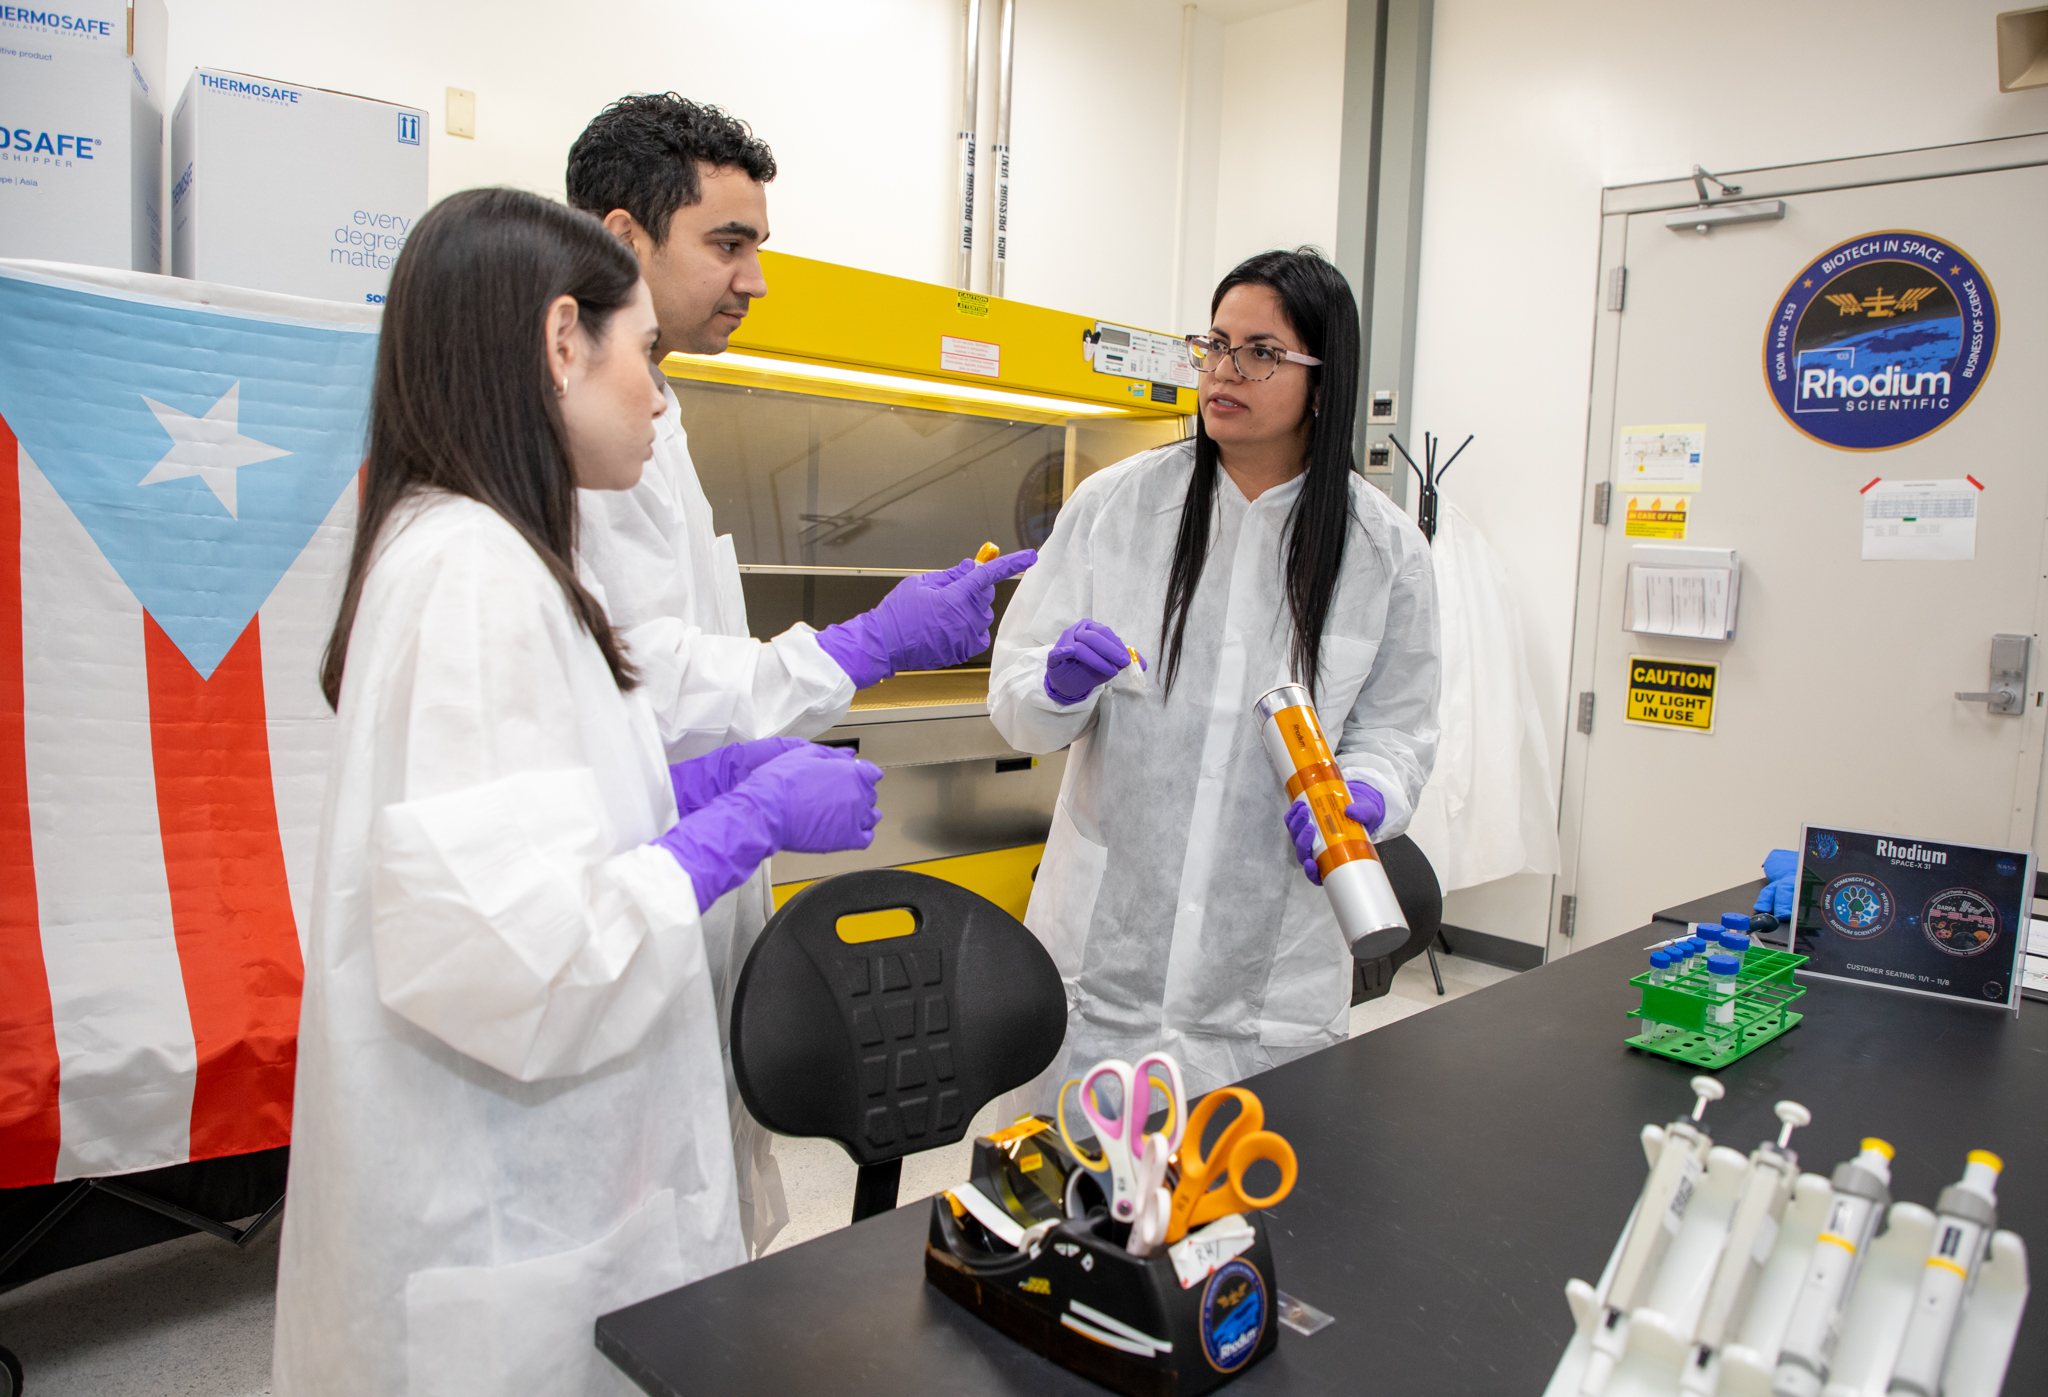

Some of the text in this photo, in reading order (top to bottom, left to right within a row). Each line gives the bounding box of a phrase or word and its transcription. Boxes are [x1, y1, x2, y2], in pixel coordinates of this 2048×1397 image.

[54, 29, 98, 40] SHIPPER
[19, 50, 53, 61] product
[2, 153, 73, 168] SHIPPER
[20, 178, 38, 187] Asia
[963, 141, 976, 250] LOW PRESSURE VENT
[997, 153, 1010, 260] HIGH PRESSURE VENT
[353, 210, 411, 235] every
[335, 225, 408, 252] degree
[1821, 240, 1945, 274] BIOTECH IN SPACE
[959, 292, 988, 302] CAUTION
[1962, 278, 1984, 379] BUSINESS OF SCIENCE
[1775, 302, 1797, 382] EST. 2014 WOSB
[1801, 365, 1952, 400] Rhodium
[1845, 397, 1951, 412] SCIENTIFIC
[1637, 512, 1656, 520] CASE
[1667, 513, 1684, 521] FIRE
[1633, 667, 1713, 689] CAUTION
[1635, 692, 1706, 710] UV LIGHT
[1643, 706, 1695, 722] IN USE
[1876, 839, 1947, 865] Rhodium
[1890, 859, 1923, 869] SPACE-X
[1833, 876, 1876, 889] DOMENECH LAB
[1936, 904, 1956, 912] DARPA
[1830, 919, 1882, 936] RHODIUM SCIENTIFIC
[1846, 963, 1884, 975] CUSTOMER
[1885, 969, 1917, 980] SEATING:
[1918, 975, 1930, 983] 11/1
[1936, 978, 1950, 986] 11/8
